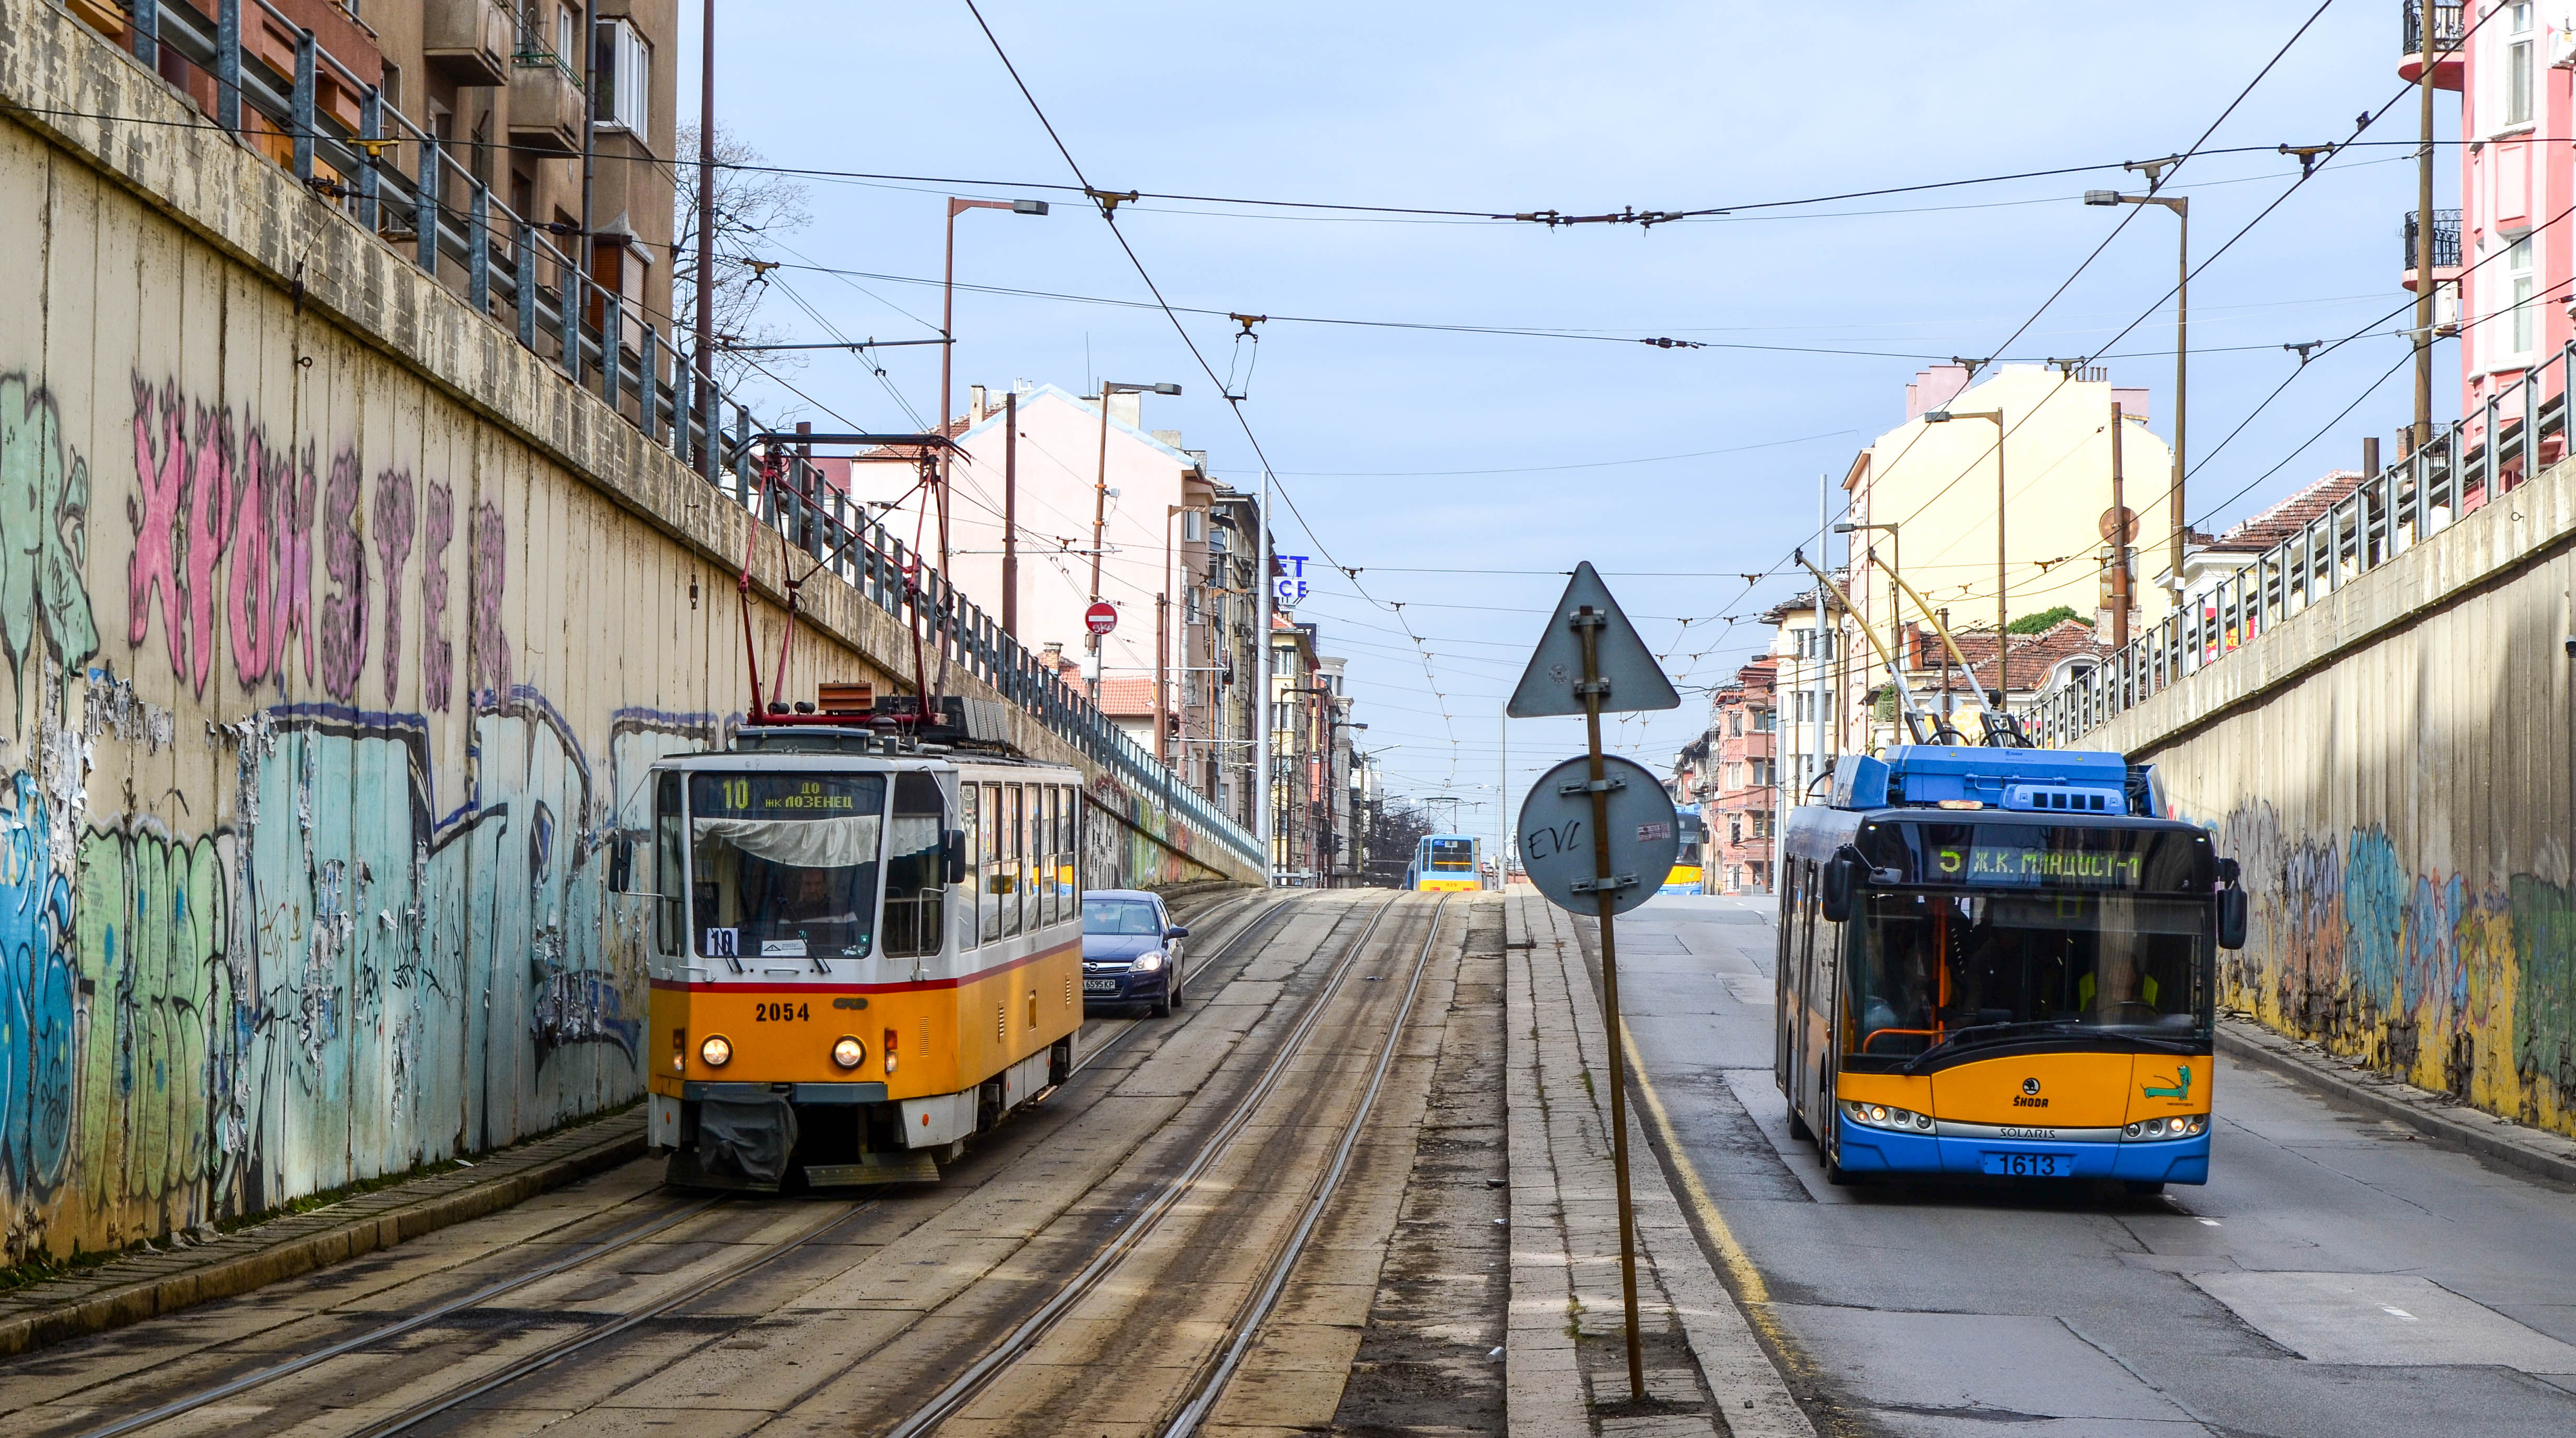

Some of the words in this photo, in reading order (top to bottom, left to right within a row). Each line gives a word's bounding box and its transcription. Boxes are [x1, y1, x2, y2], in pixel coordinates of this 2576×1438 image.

[723, 779, 748, 809] 10
[786, 796, 853, 809] ЛОЗЕНЕЦ
[1940, 850, 1960, 872] 5
[711, 930, 733, 956] 10
[756, 1003, 809, 1021] 2054
[2013, 1095, 2049, 1108] ŠKODA
[2000, 1128, 2055, 1140] SOLARIS
[1999, 1155, 2055, 1176] 1613
